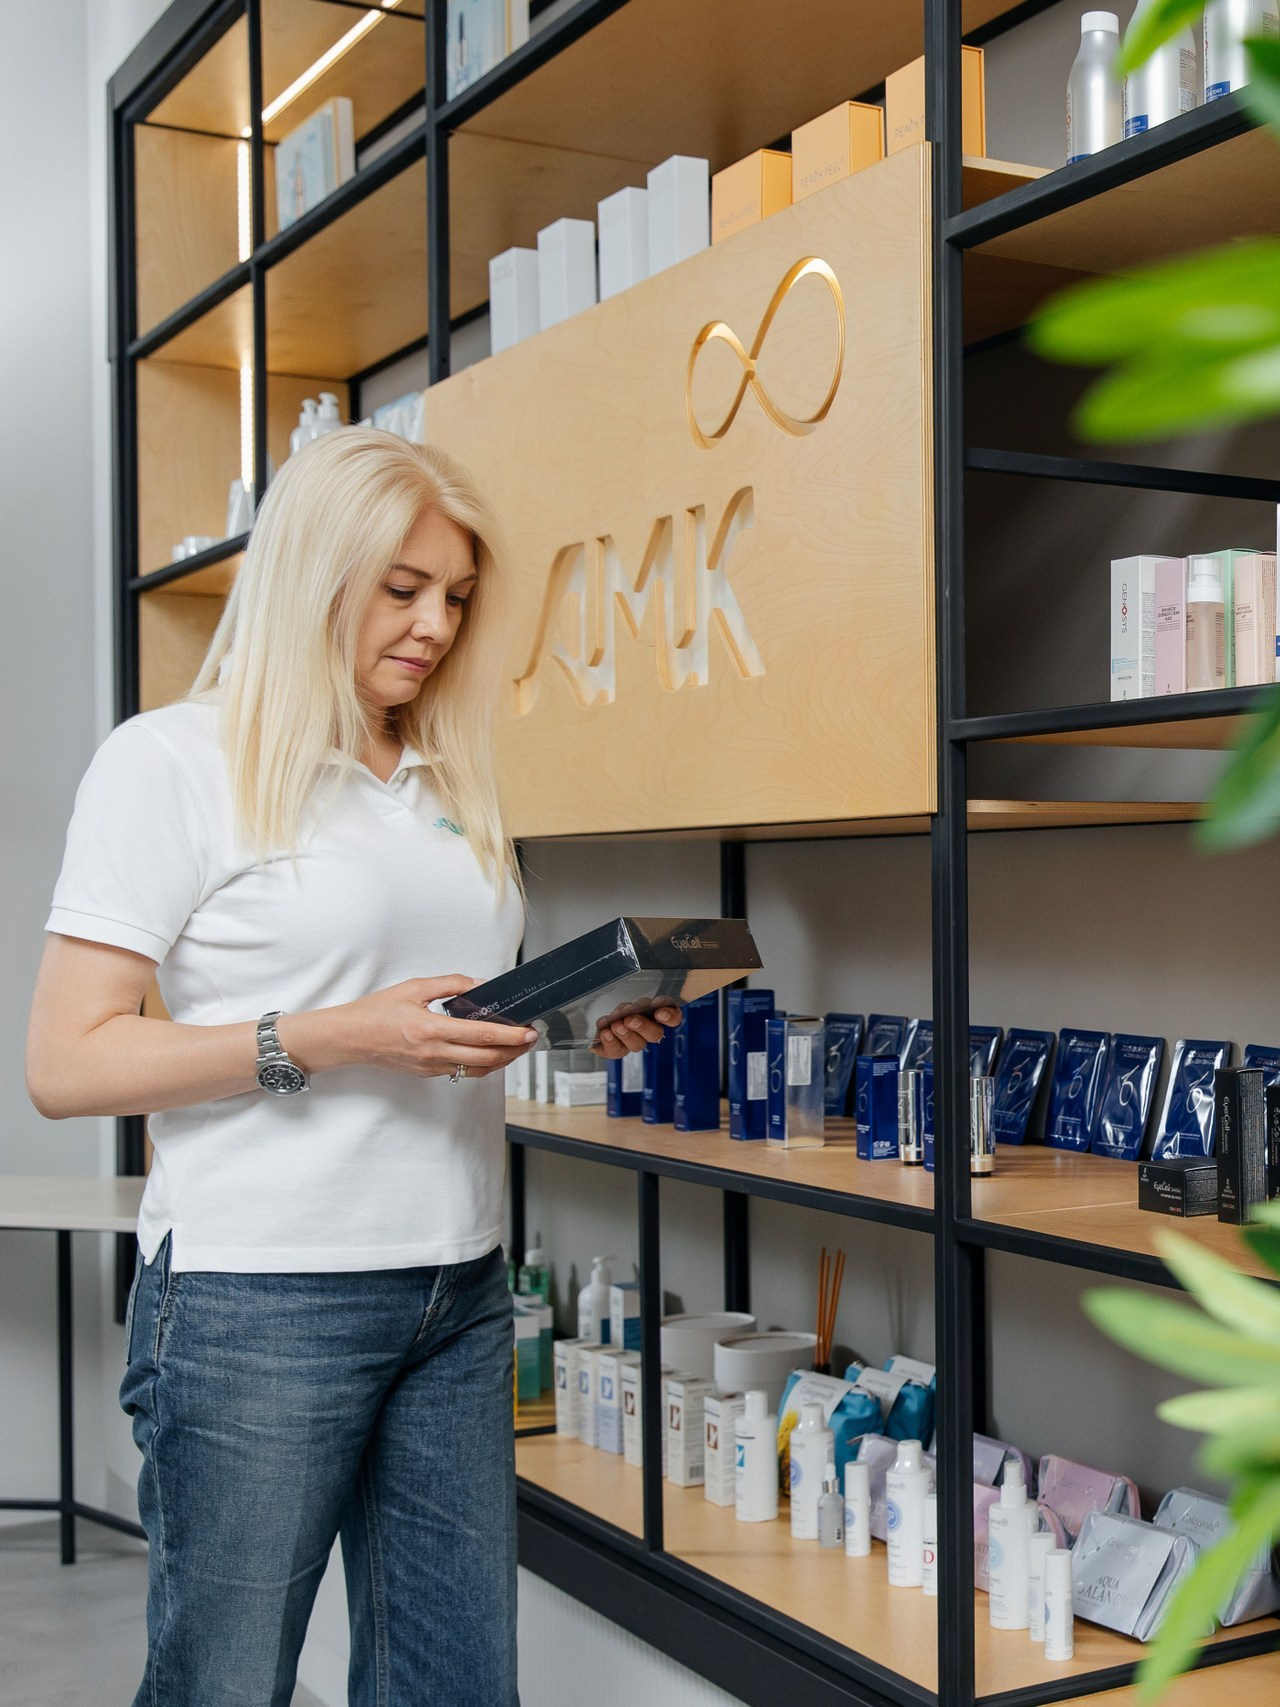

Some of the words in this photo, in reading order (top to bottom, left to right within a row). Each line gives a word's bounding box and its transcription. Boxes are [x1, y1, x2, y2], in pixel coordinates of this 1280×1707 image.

[670, 934, 702, 952] EyeCell
[466, 1001, 500, 1020] GENOSYS
[1222, 1096, 1231, 1132] EyeCell
[1096, 1575, 1120, 1590] AQUA
